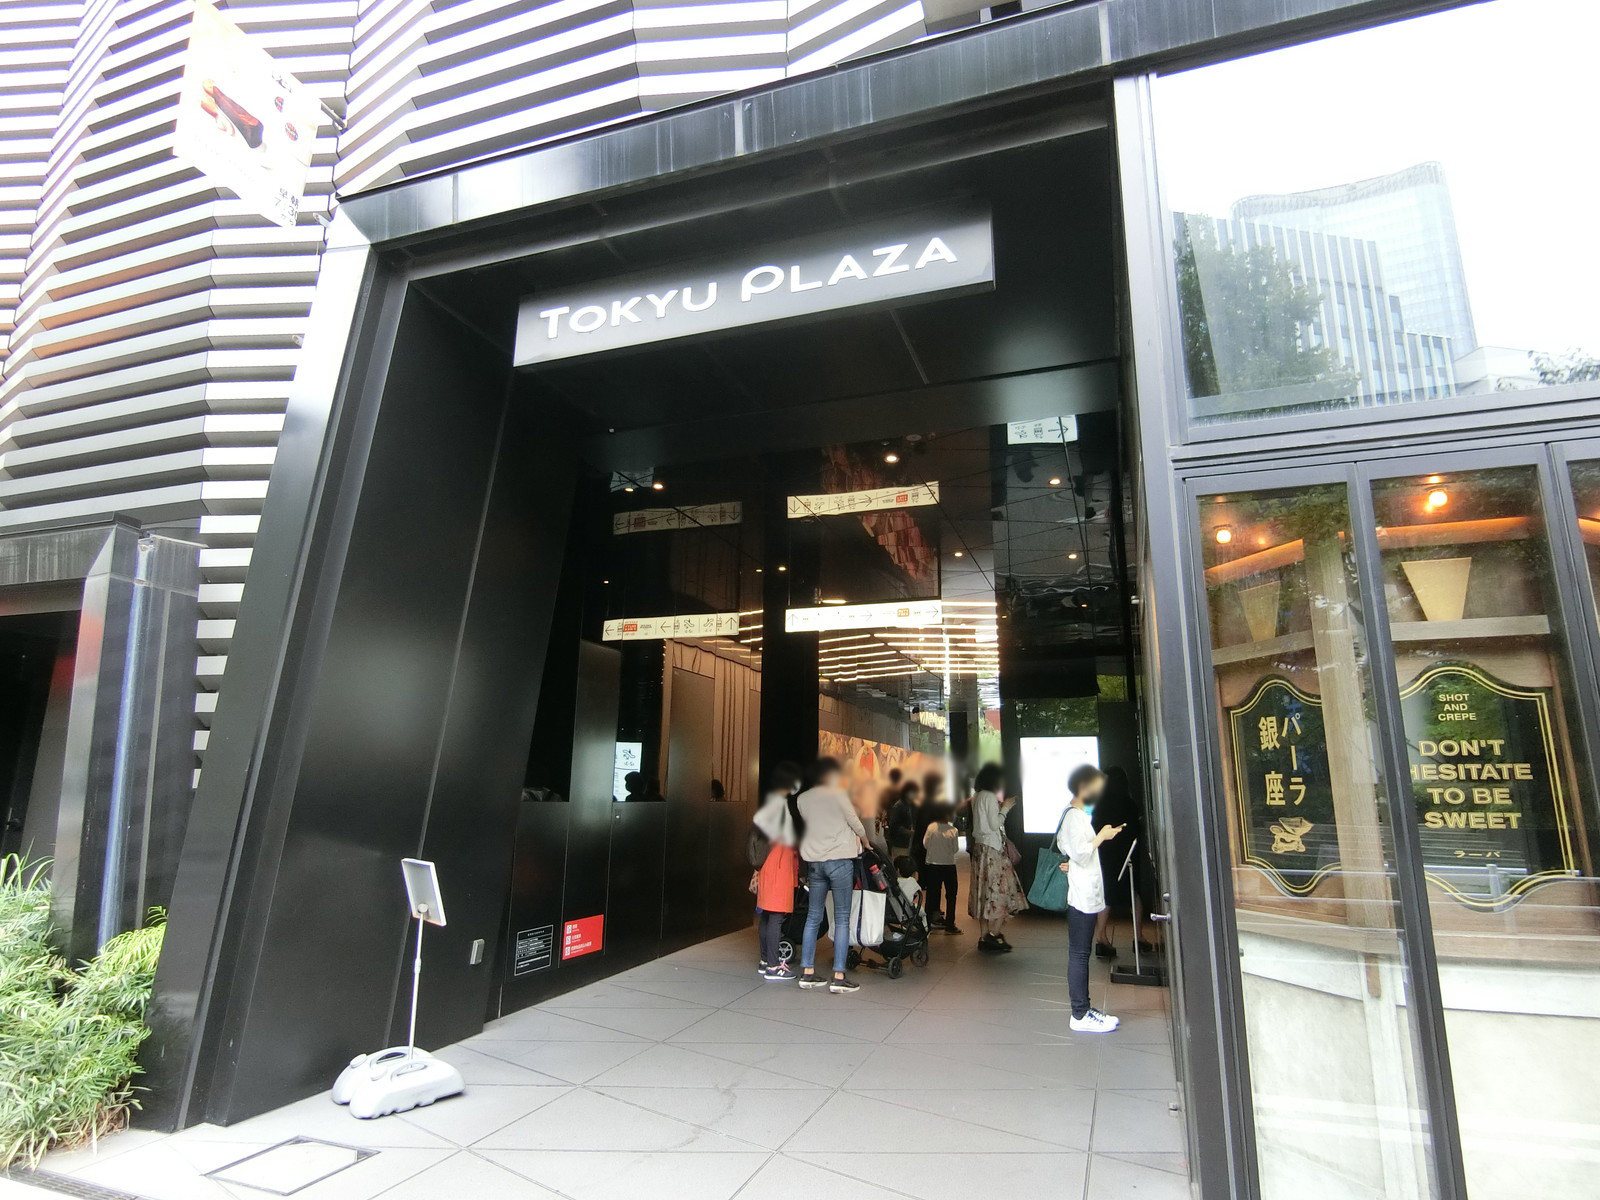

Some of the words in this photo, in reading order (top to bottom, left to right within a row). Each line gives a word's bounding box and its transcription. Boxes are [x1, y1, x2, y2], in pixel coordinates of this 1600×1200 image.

[539, 281, 718, 339] TOKYU
[741, 236, 958, 302] PLAZA
[1438, 693, 1470, 702] SHOT
[1443, 703, 1468, 711] AND
[1437, 712, 1477, 721] CREPE
[1418, 740, 1505, 757] DON'T
[1410, 763, 1533, 780] HESITATE
[1426, 787, 1466, 805] TO
[1472, 788, 1513, 805] BE
[1424, 811, 1522, 829] SWEET
